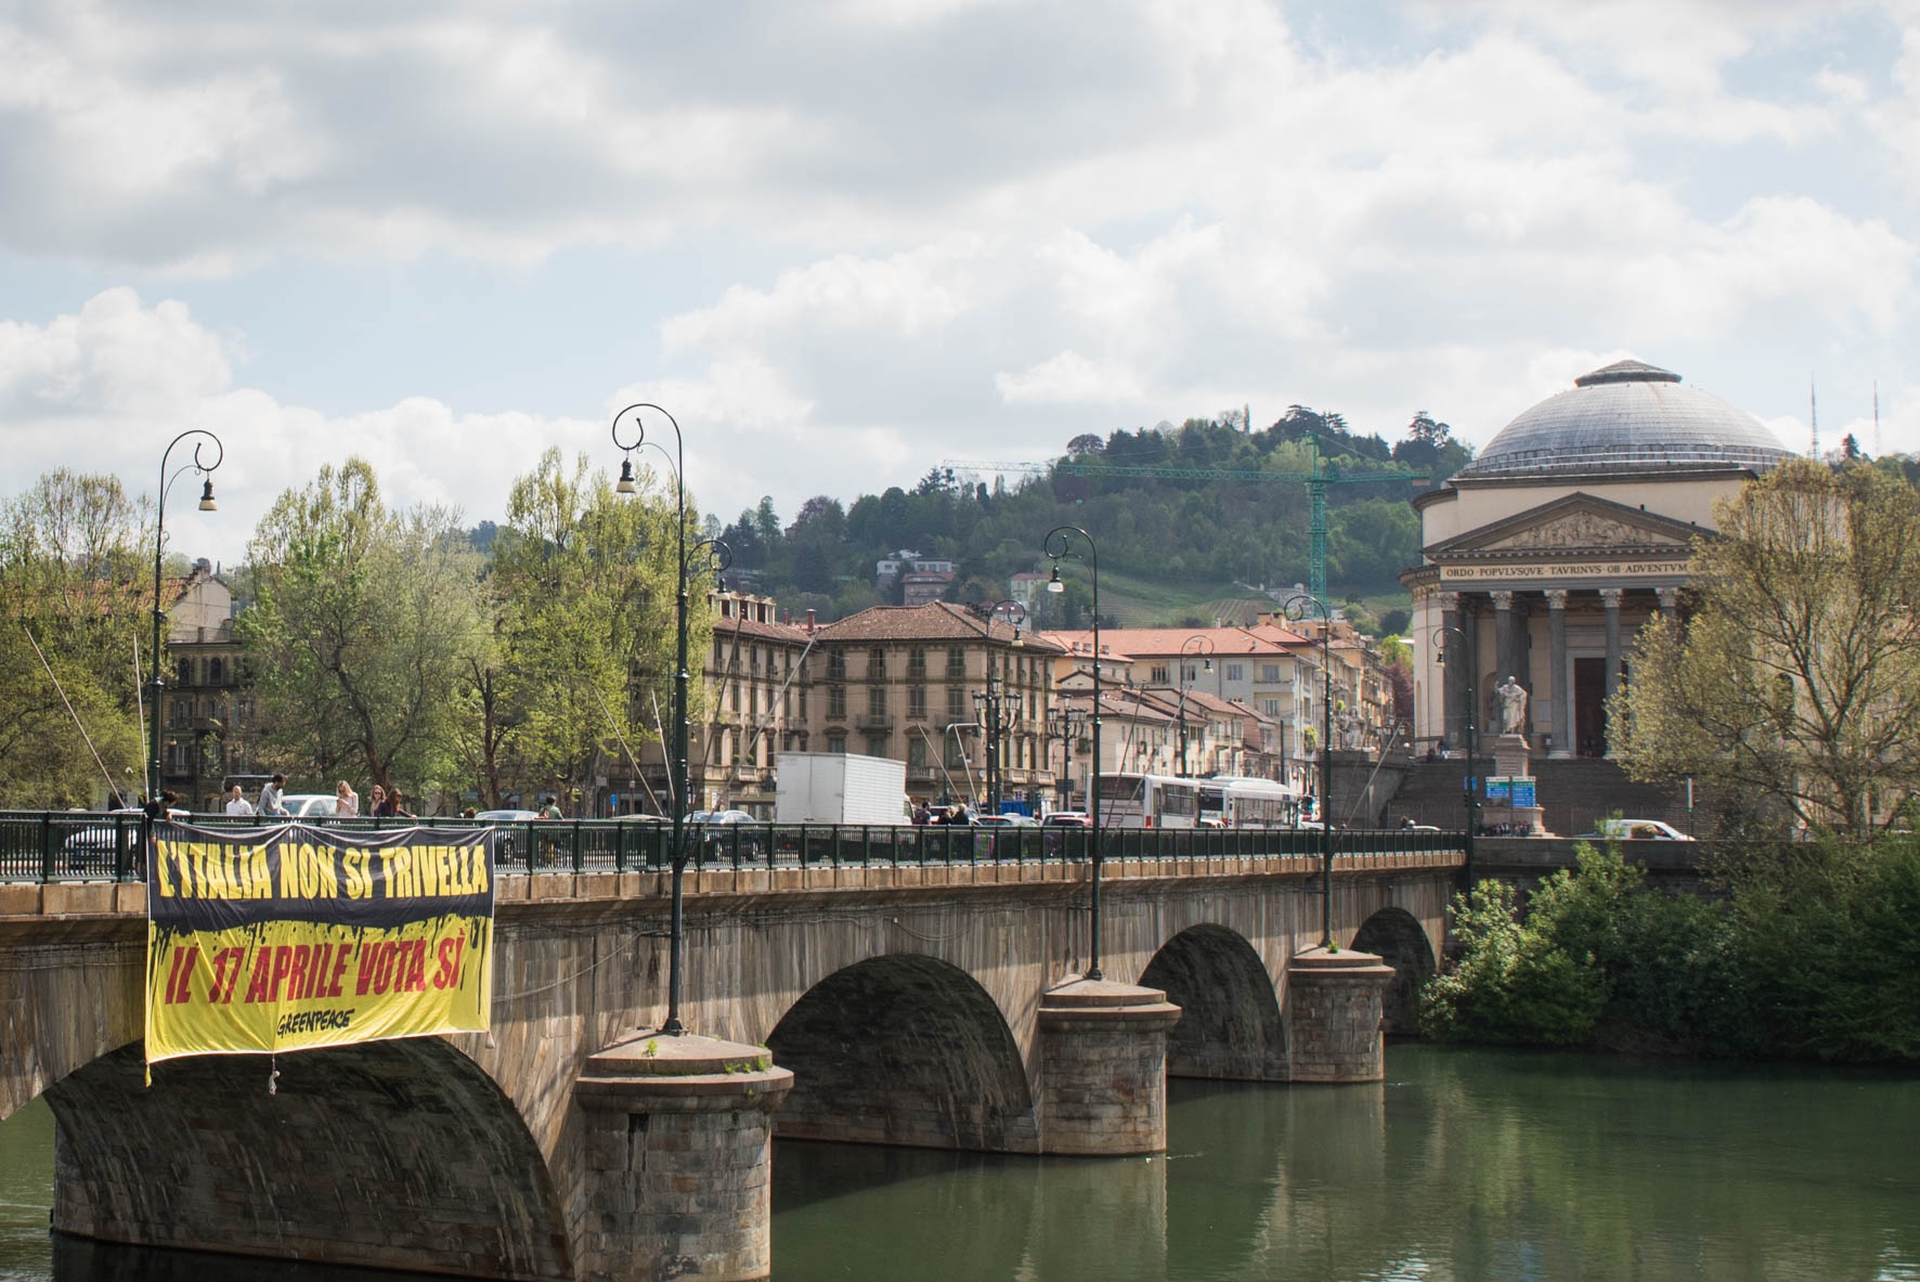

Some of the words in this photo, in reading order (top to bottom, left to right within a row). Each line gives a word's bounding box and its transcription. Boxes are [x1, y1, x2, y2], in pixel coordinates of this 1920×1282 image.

[1446, 568, 1475, 578] ORDO
[1480, 566, 1544, 577] POPVLVSQVE
[1550, 565, 1602, 576] TAVRINVS
[1607, 564, 1621, 574] OB
[1625, 563, 1689, 574] ADVENTVM
[157, 840, 272, 900] L'ITALIA
[279, 843, 338, 900] NON
[344, 847, 373, 900] SI
[378, 844, 489, 899] TRIVELLA
[164, 946, 200, 1006] IL
[208, 947, 246, 1005] 17
[244, 943, 353, 1004] APRILE
[355, 939, 428, 996] VOTA
[432, 927, 467, 991] SÌ
[276, 1008, 356, 1039] GREENPEACE
